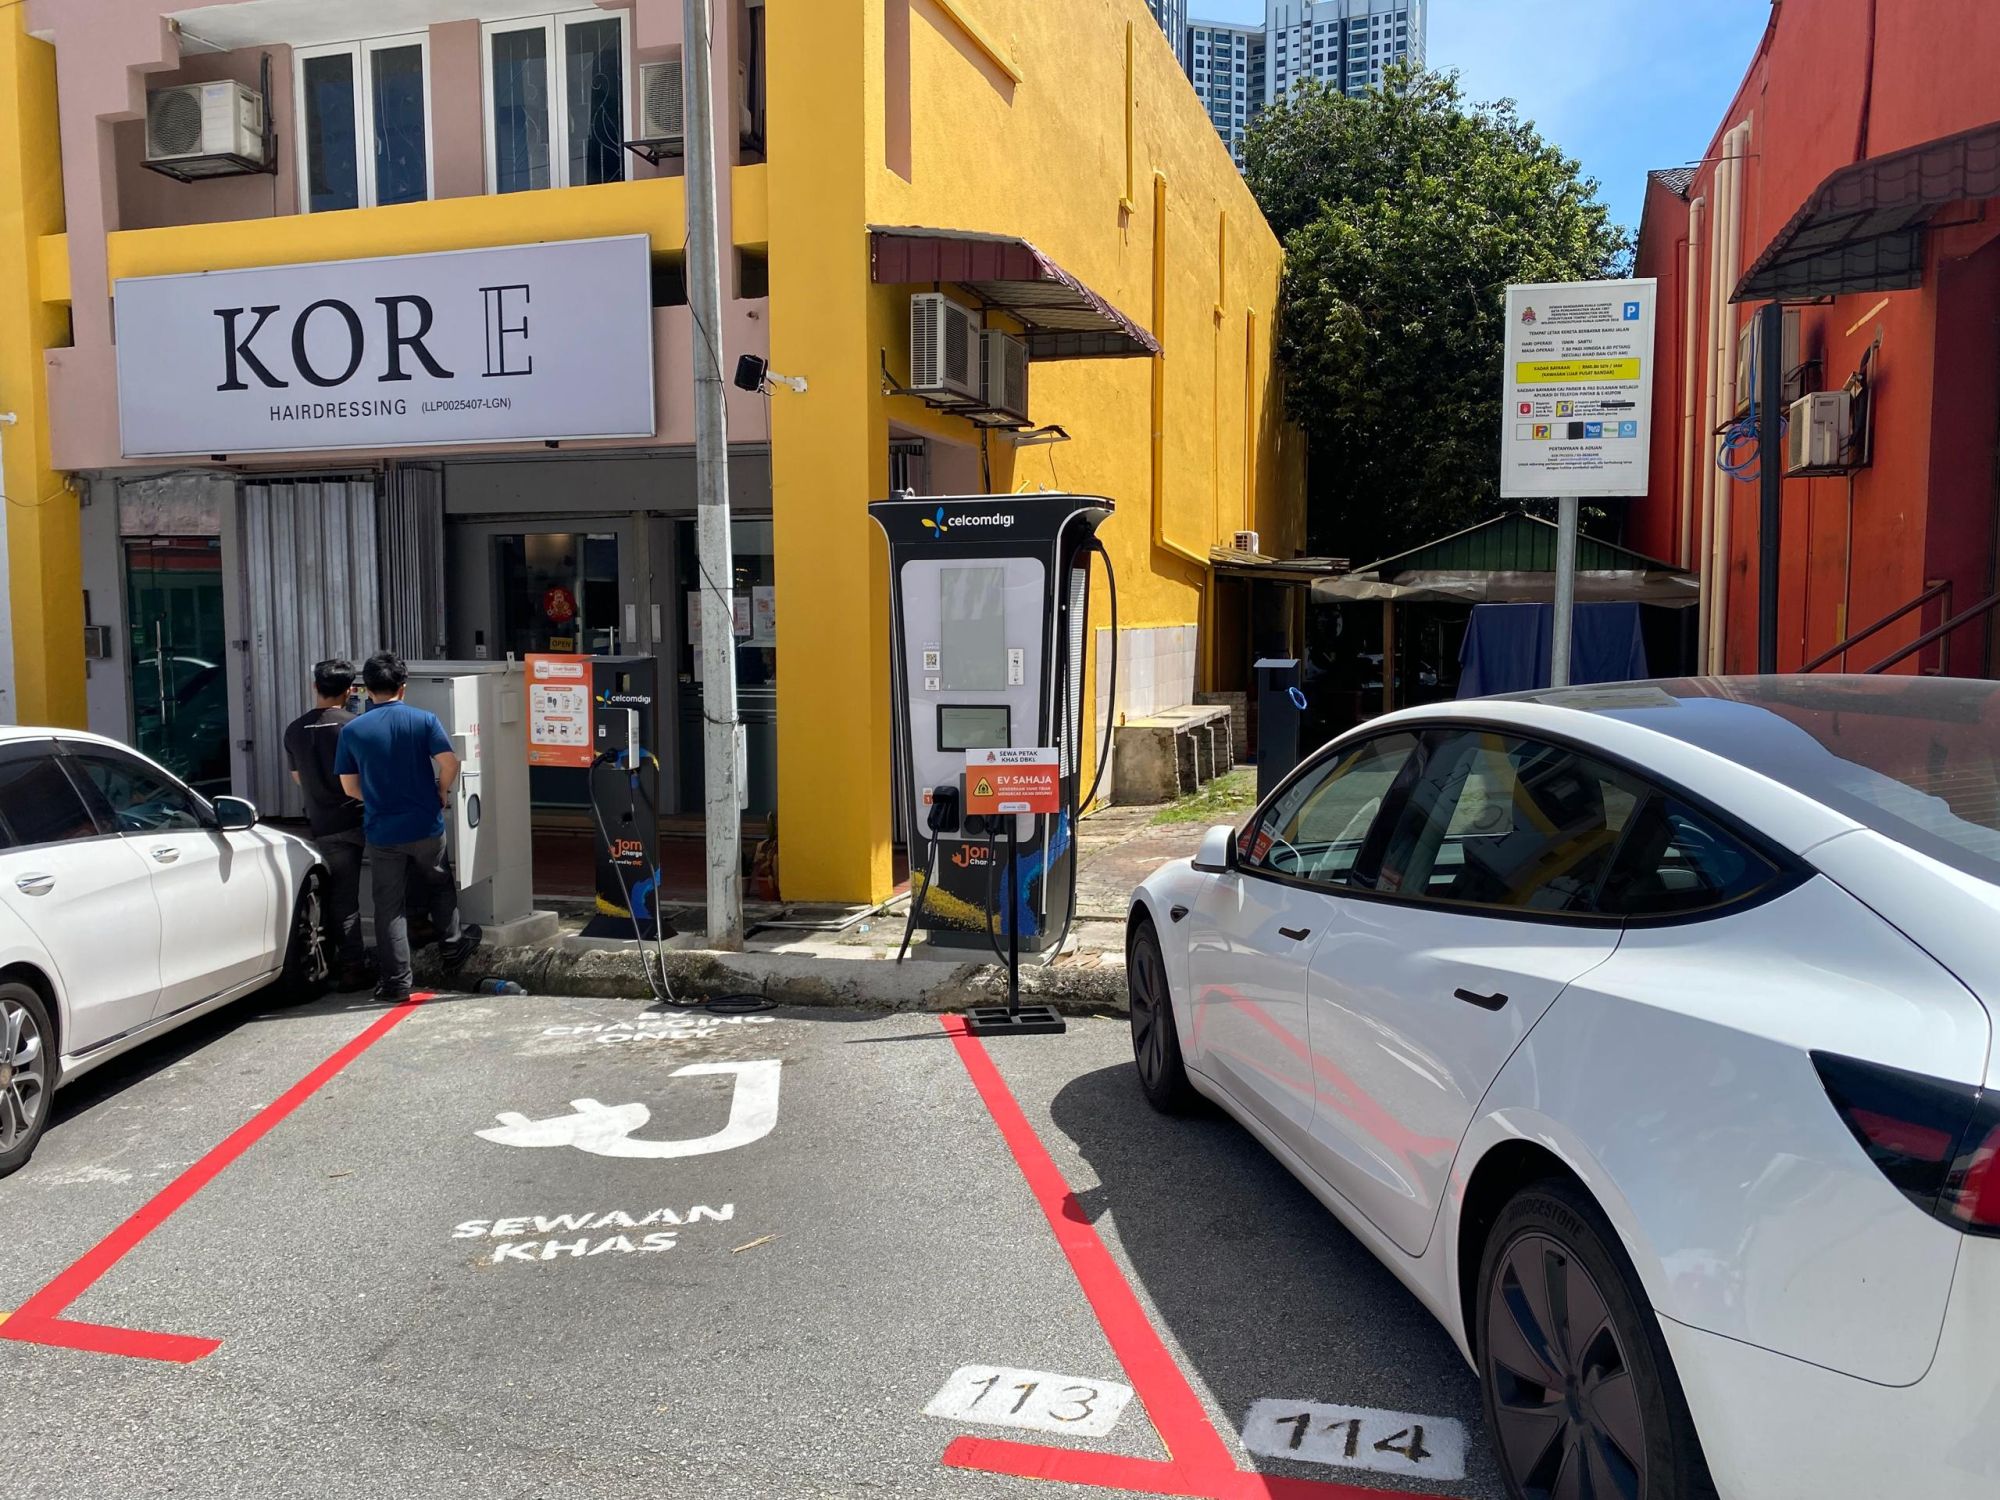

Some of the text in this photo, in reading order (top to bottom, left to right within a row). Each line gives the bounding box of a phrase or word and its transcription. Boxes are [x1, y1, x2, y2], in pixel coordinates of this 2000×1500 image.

[1627, 305, 1636, 317] P
[269, 396, 512, 420] HAIRDRESSING (LLP0025407-LGN)
[948, 513, 1014, 527] celcomdigi
[552, 640, 571, 648] OPEN
[612, 695, 651, 705] celcomdigi
[997, 776, 1052, 784] EV SAHAJA
[612, 839, 642, 858] Jom
[621, 850, 643, 858] Charge
[969, 858, 996, 866] Chare
[543, 1015, 775, 1036] CHARGING
[595, 1027, 717, 1043] ONLY
[451, 1203, 735, 1239] SEWAAN
[493, 1231, 678, 1263] KHAS
[971, 1375, 1100, 1422] 113
[1276, 1412, 1432, 1463] 114
